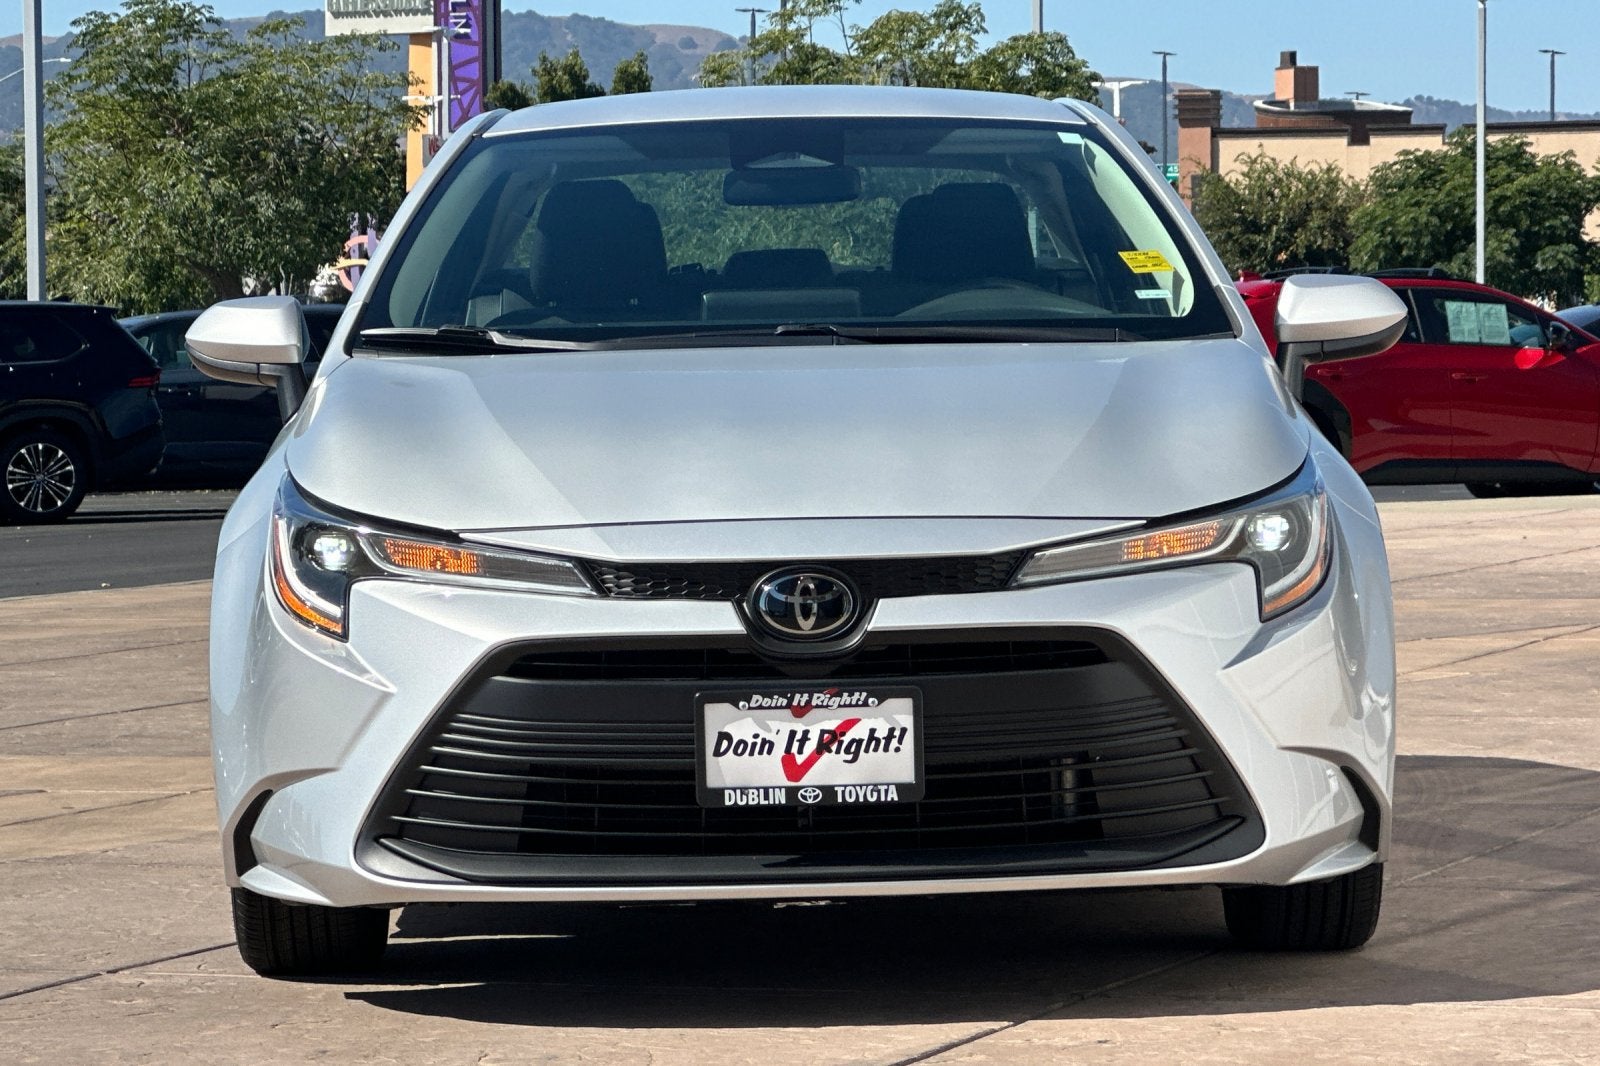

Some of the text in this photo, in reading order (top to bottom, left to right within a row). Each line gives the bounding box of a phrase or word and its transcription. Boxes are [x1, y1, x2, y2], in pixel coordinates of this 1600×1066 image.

[749, 692, 867, 710] Doin' It Right!
[712, 726, 908, 764] Doin' It Right!
[724, 784, 899, 806] DUBLIN TOYOTA
